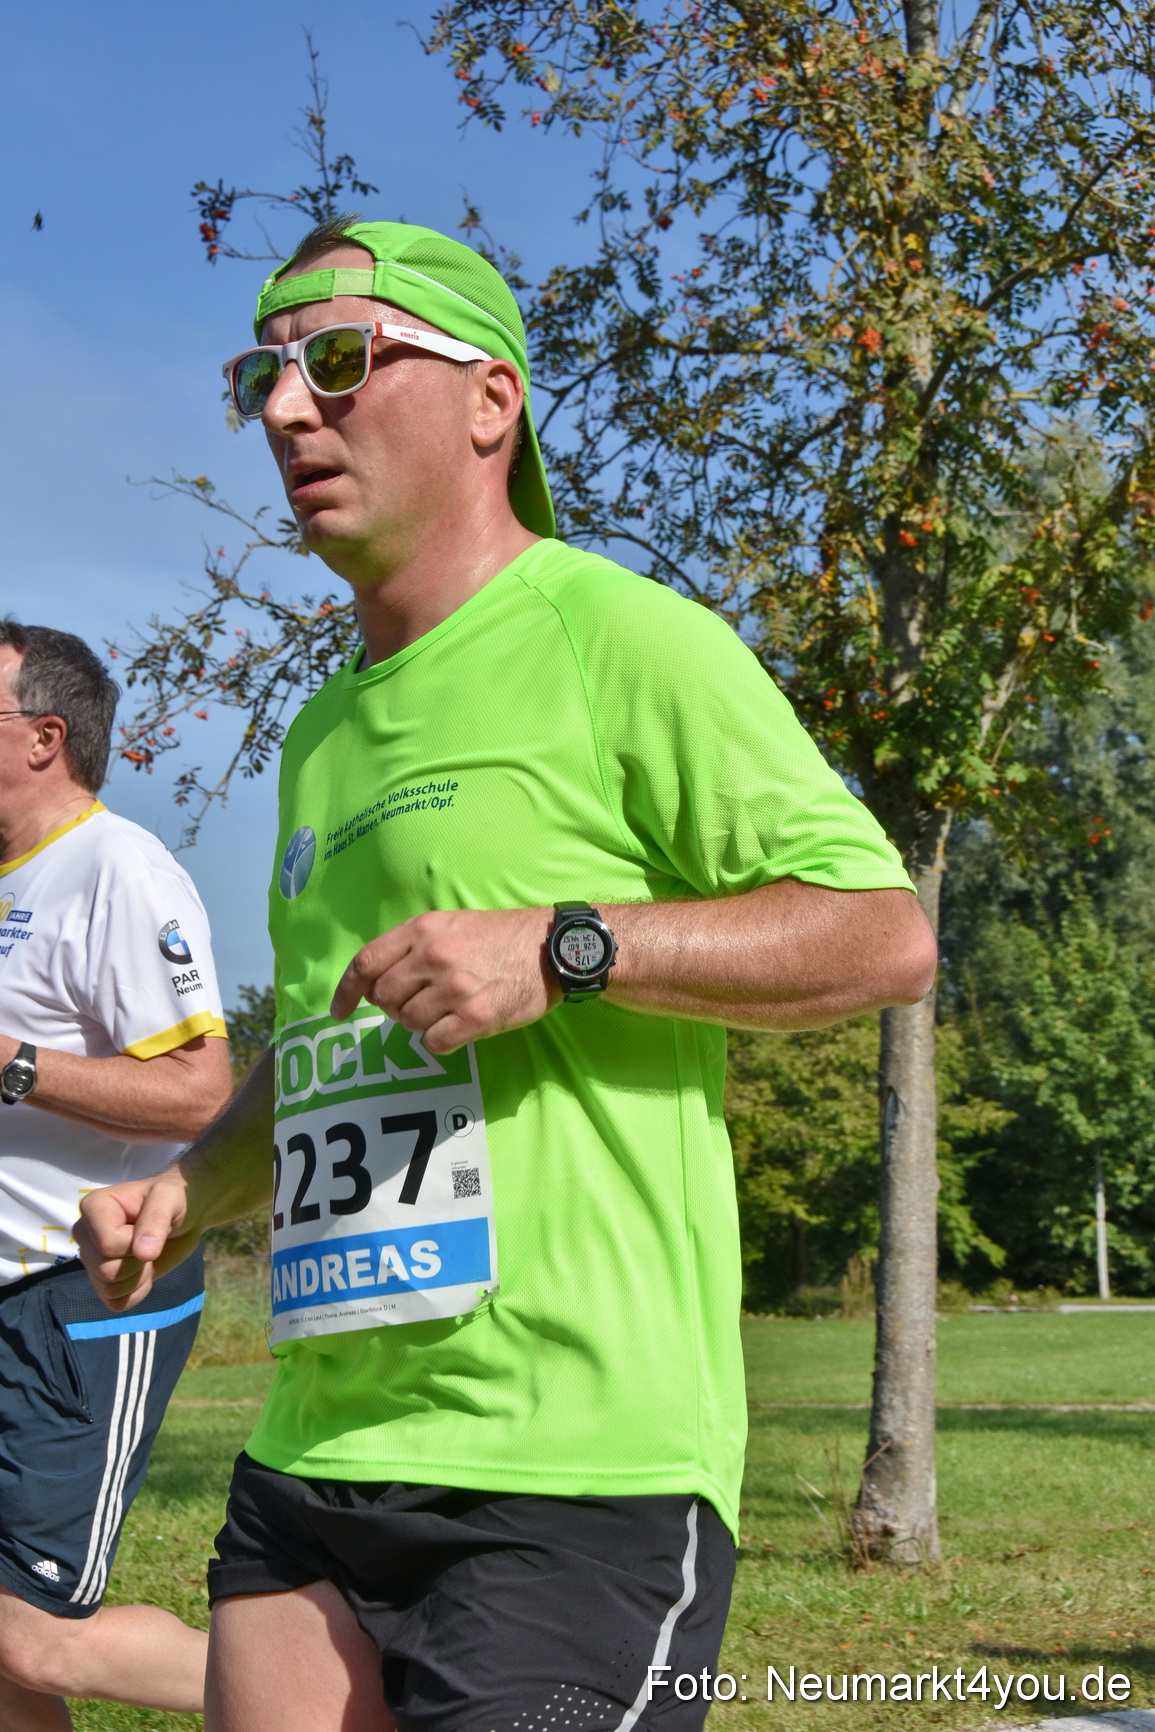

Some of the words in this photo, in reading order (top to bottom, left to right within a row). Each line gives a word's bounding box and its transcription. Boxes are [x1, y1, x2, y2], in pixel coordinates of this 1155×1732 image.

[323, 850, 333, 861] im
[333, 840, 347, 857] Haus
[380, 795, 455, 823] Neumarkt/Opf.
[326, 827, 343, 845] Freie
[343, 799, 386, 834] katholische
[388, 779, 459, 805] Volksschule
[171, 969, 200, 988] PAR
[275, 1015, 448, 1113] OCK
[452, 1113, 468, 1131] D
[273, 1239, 442, 1305] ANDREAS
[31, 1564, 61, 1583] adidas
